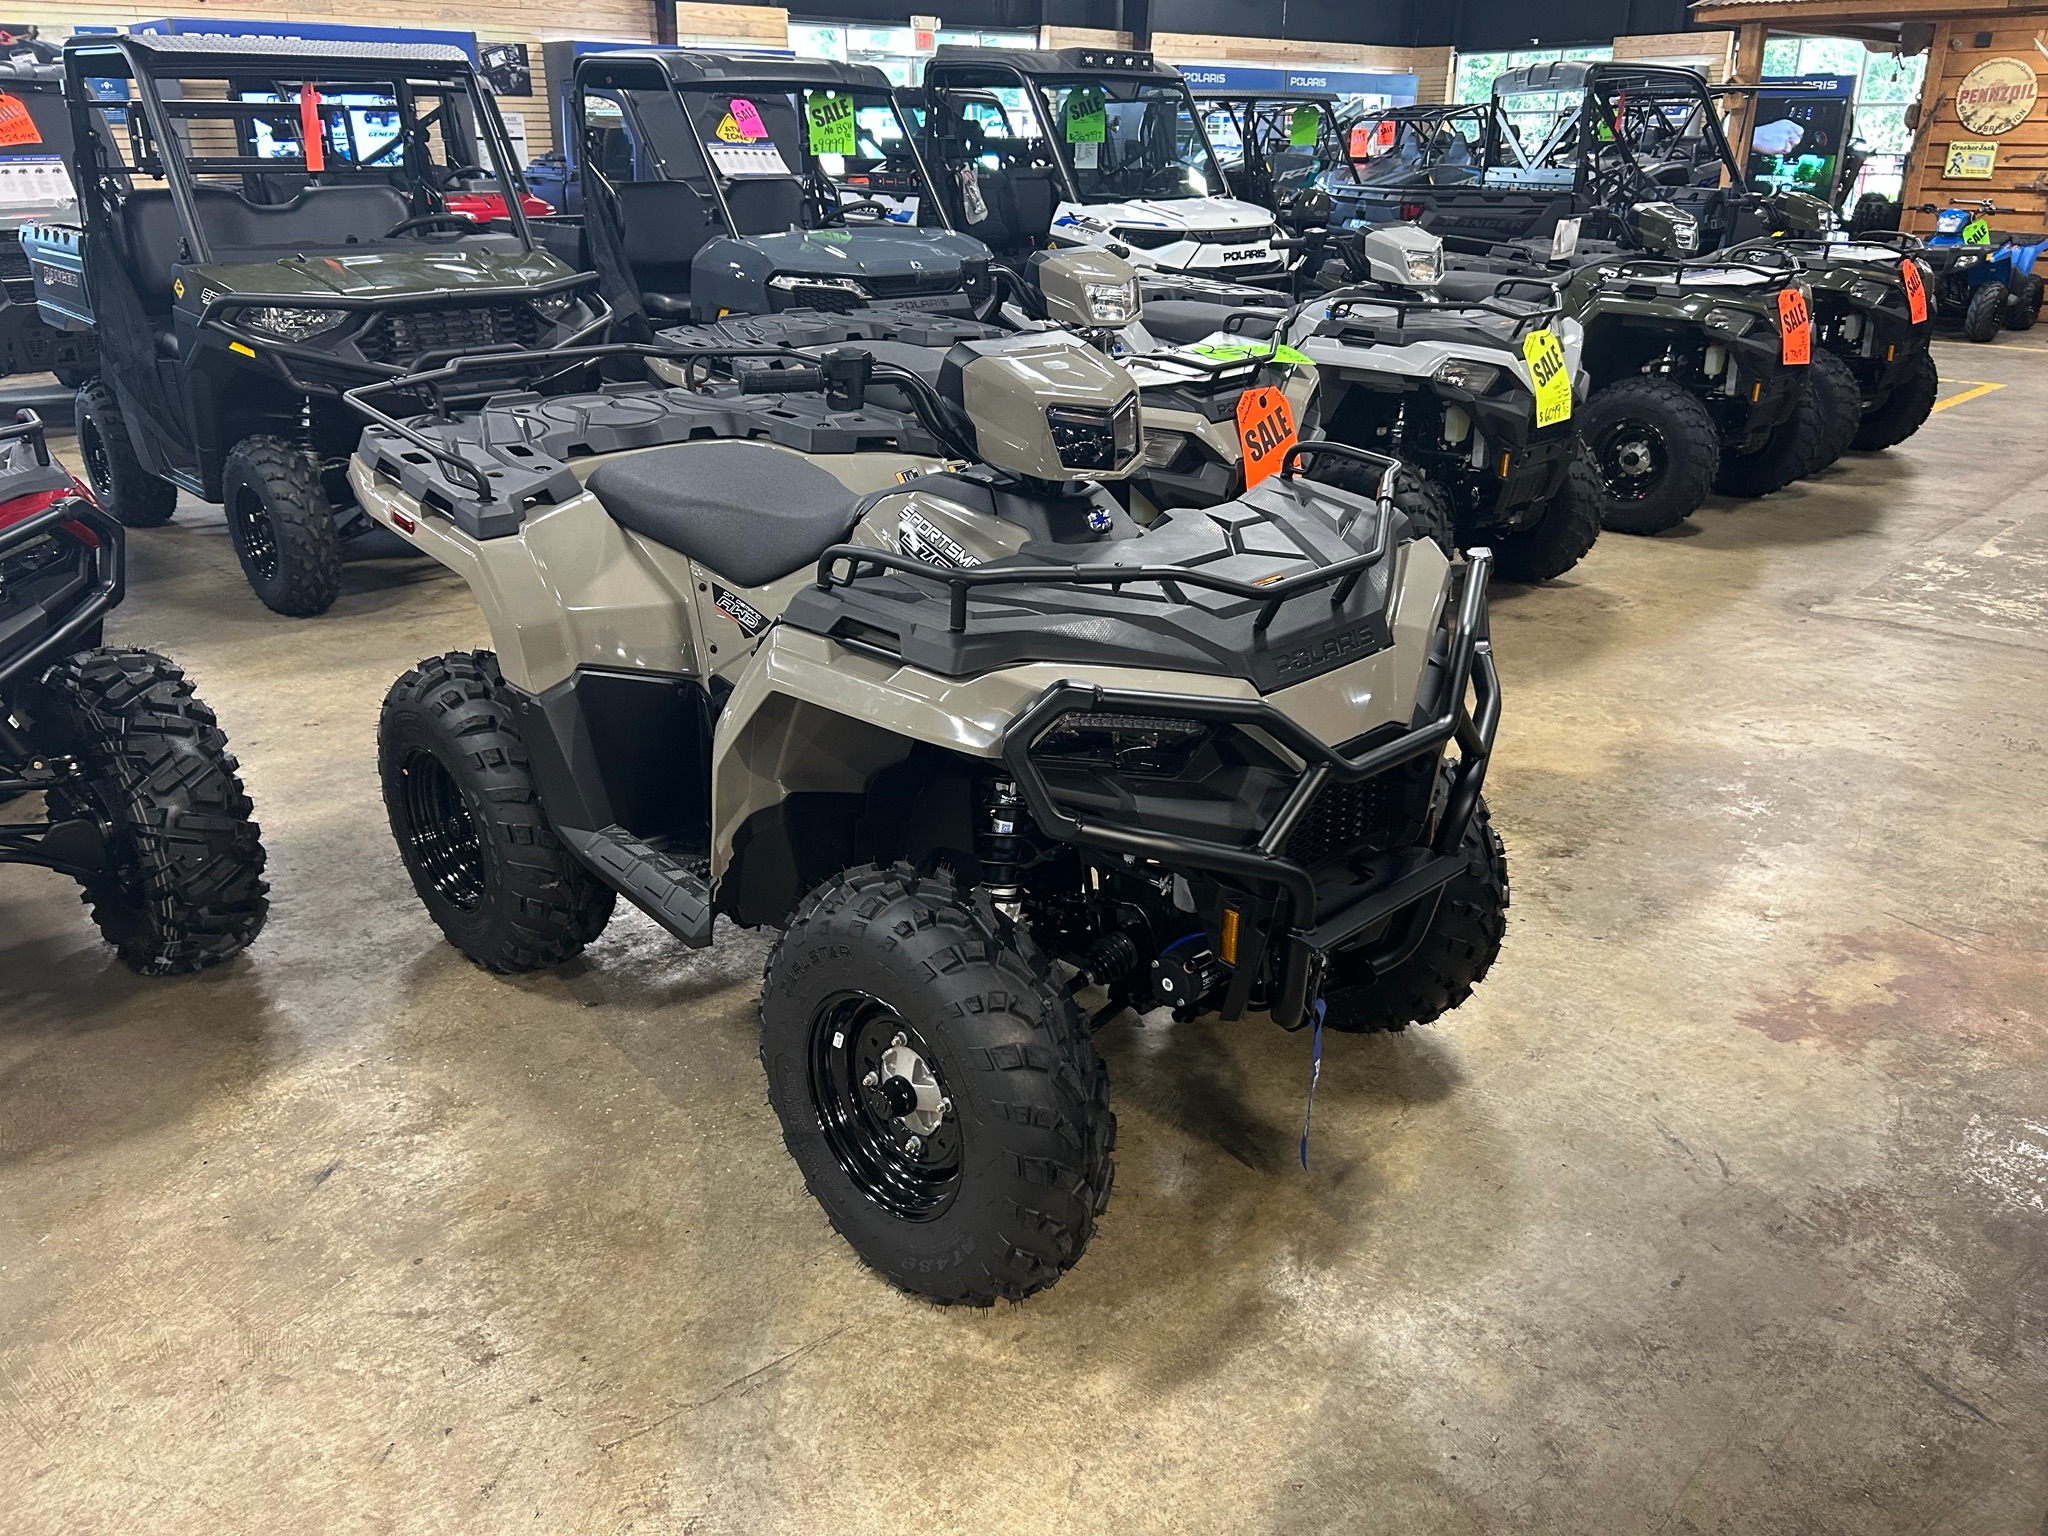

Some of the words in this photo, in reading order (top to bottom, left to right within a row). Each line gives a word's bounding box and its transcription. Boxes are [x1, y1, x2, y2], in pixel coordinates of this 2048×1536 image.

[1184, 72, 1226, 83] POLARIS
[1290, 77, 1327, 87] POLARIS
[1958, 83, 2035, 105] PENNZOIL
[735, 107, 757, 122] SALE
[811, 98, 851, 127] SALE
[1069, 96, 1103, 121] SALE
[824, 126, 834, 135] No
[1352, 133, 1366, 145] SALE
[1379, 125, 1393, 136] SALE
[1966, 225, 1988, 245] SALE
[1223, 249, 1267, 262] POLARIS
[43, 266, 78, 288] RANGER
[1907, 269, 1922, 298] SALE
[895, 298, 949, 309] POLARIS
[1783, 302, 1807, 334] SALE
[1533, 344, 1563, 388] SALE
[1245, 406, 1292, 462] SALE
[898, 504, 982, 568] SPORTSMA
[716, 596, 759, 629] AWD
[1272, 625, 1376, 678] POLARIS
